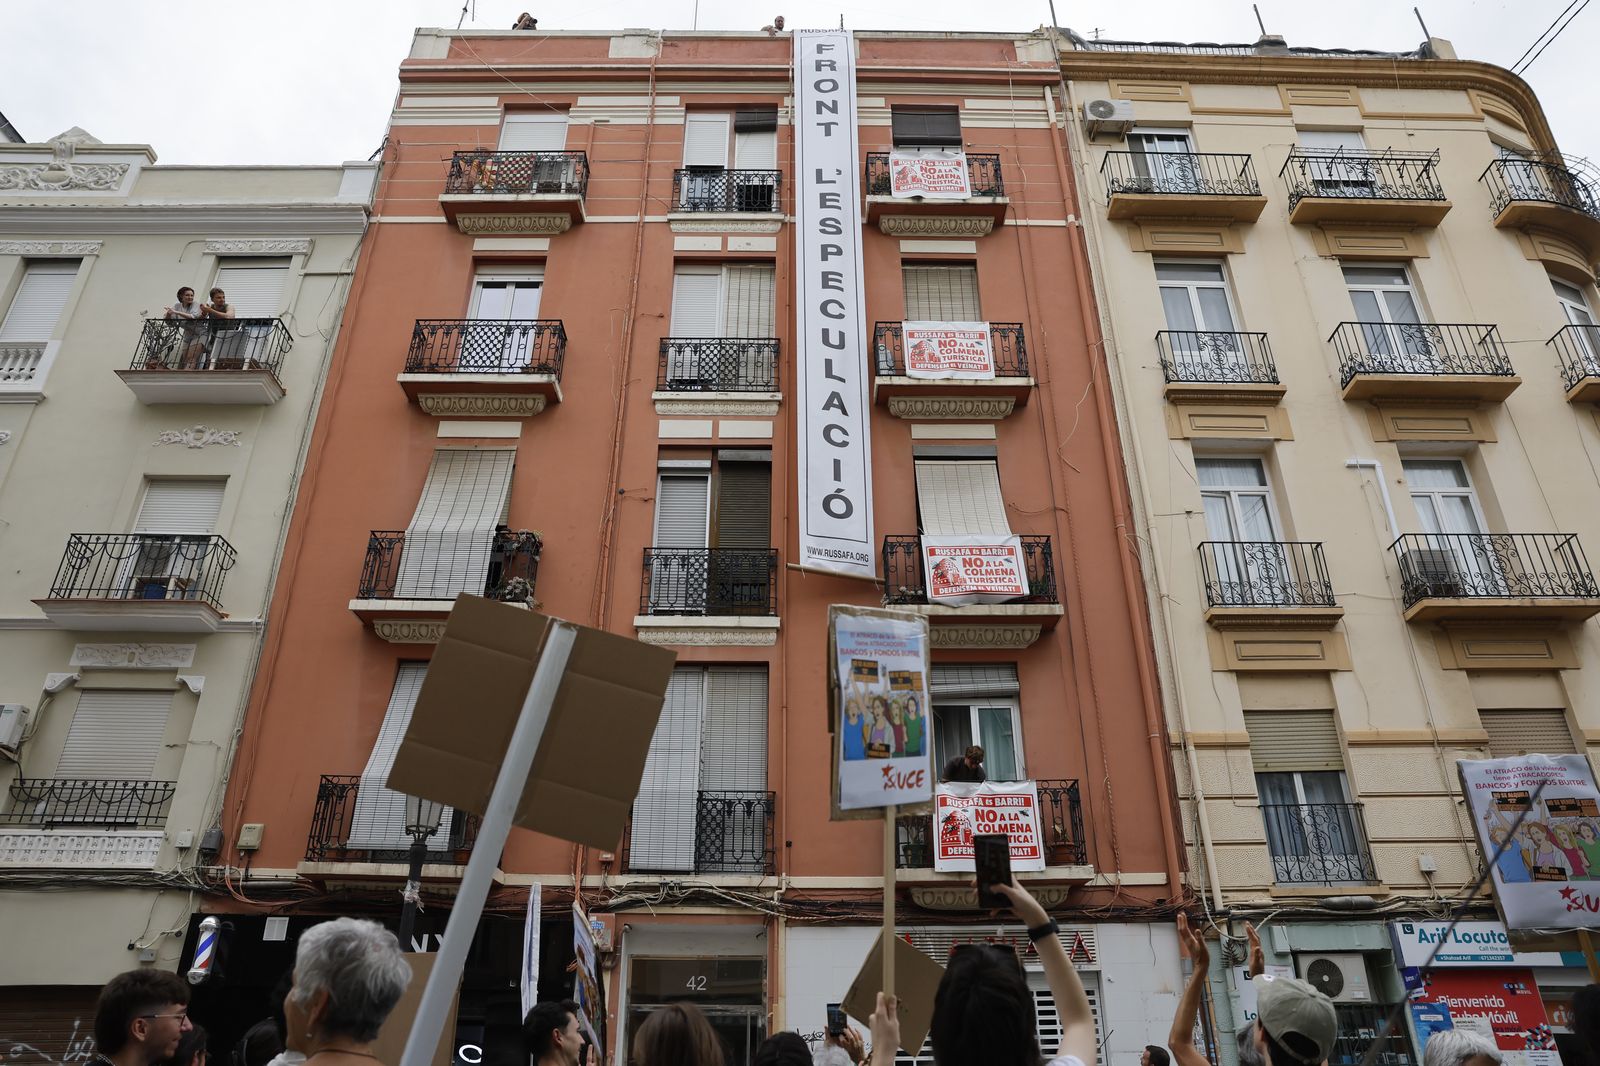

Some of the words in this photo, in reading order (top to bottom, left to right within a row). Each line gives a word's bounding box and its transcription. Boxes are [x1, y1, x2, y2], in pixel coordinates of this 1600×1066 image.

[814, 43, 840, 137] FRONT
[920, 166, 937, 174] NO
[815, 168, 854, 519] L'ESPECULACIÓ
[938, 339, 957, 348] NO
[939, 348, 985, 356] COLMENA
[806, 545, 869, 562] WWW.RUSSAFA.ORG
[935, 548, 971, 556] RUSSAFA
[981, 548, 1008, 556] BARRI!
[962, 557, 984, 568] NO
[964, 568, 1016, 576] COLMENA
[939, 585, 977, 594] DEFENSEM
[1493, 766, 1522, 774] ATRACO
[1475, 782, 1512, 790] BANCOS
[946, 797, 984, 808] RUSSAFA
[994, 797, 1025, 806] BARRI!
[974, 809, 998, 823] NO
[999, 813, 1006, 821] A
[1008, 813, 1020, 821] LA
[976, 823, 1033, 833] COLMENA
[1007, 834, 1034, 844] TICA!
[947, 847, 976, 855] DEFENS
[1418, 927, 1448, 944] Arif
[686, 975, 708, 991] 42
[1481, 1010, 1519, 1024] Móvil!
